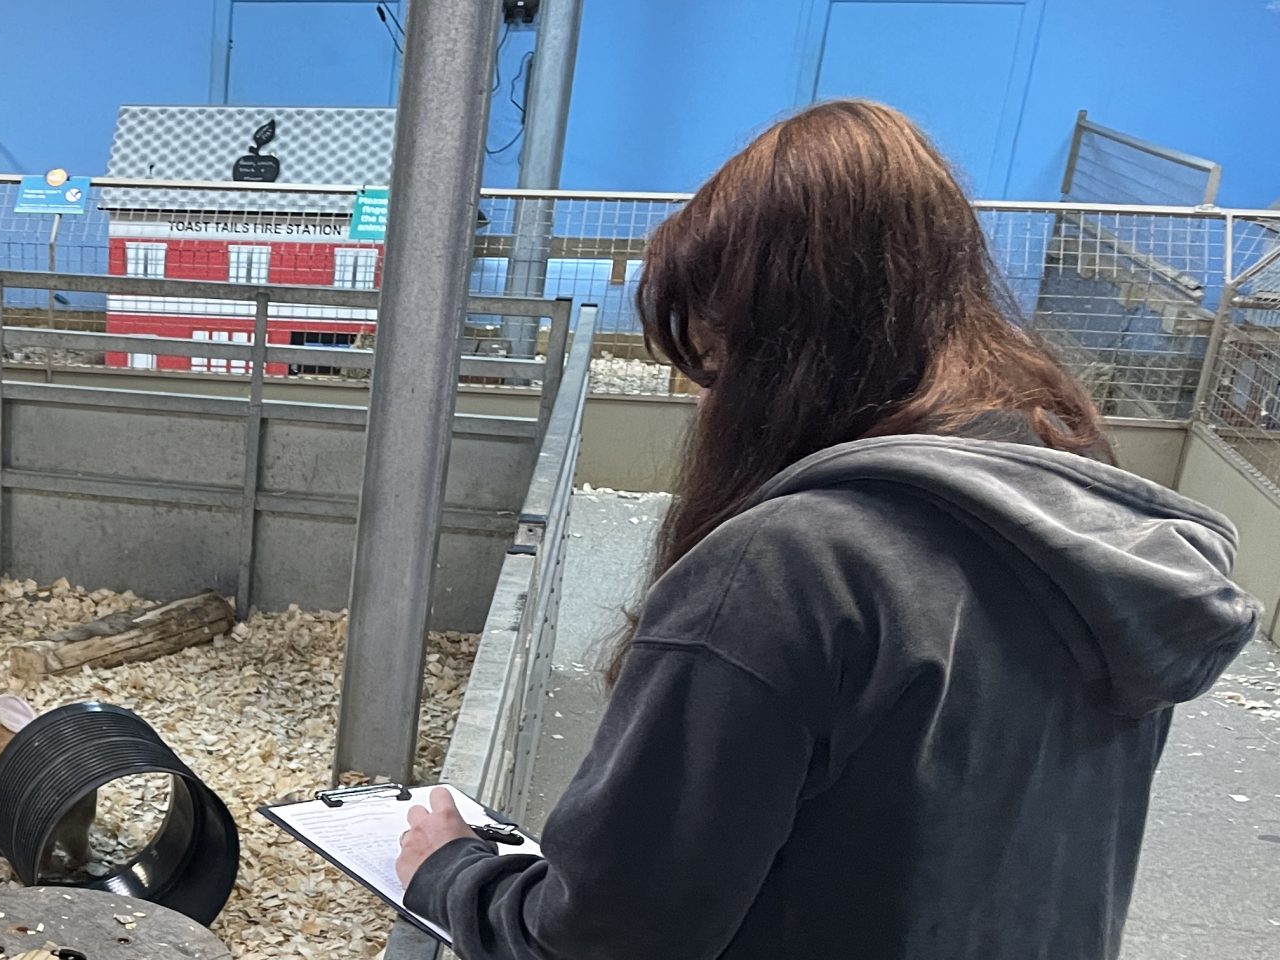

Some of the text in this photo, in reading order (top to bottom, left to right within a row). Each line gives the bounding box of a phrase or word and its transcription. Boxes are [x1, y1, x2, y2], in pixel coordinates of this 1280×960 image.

[168, 220, 342, 236] TOAST TAILS FIRE STATION
